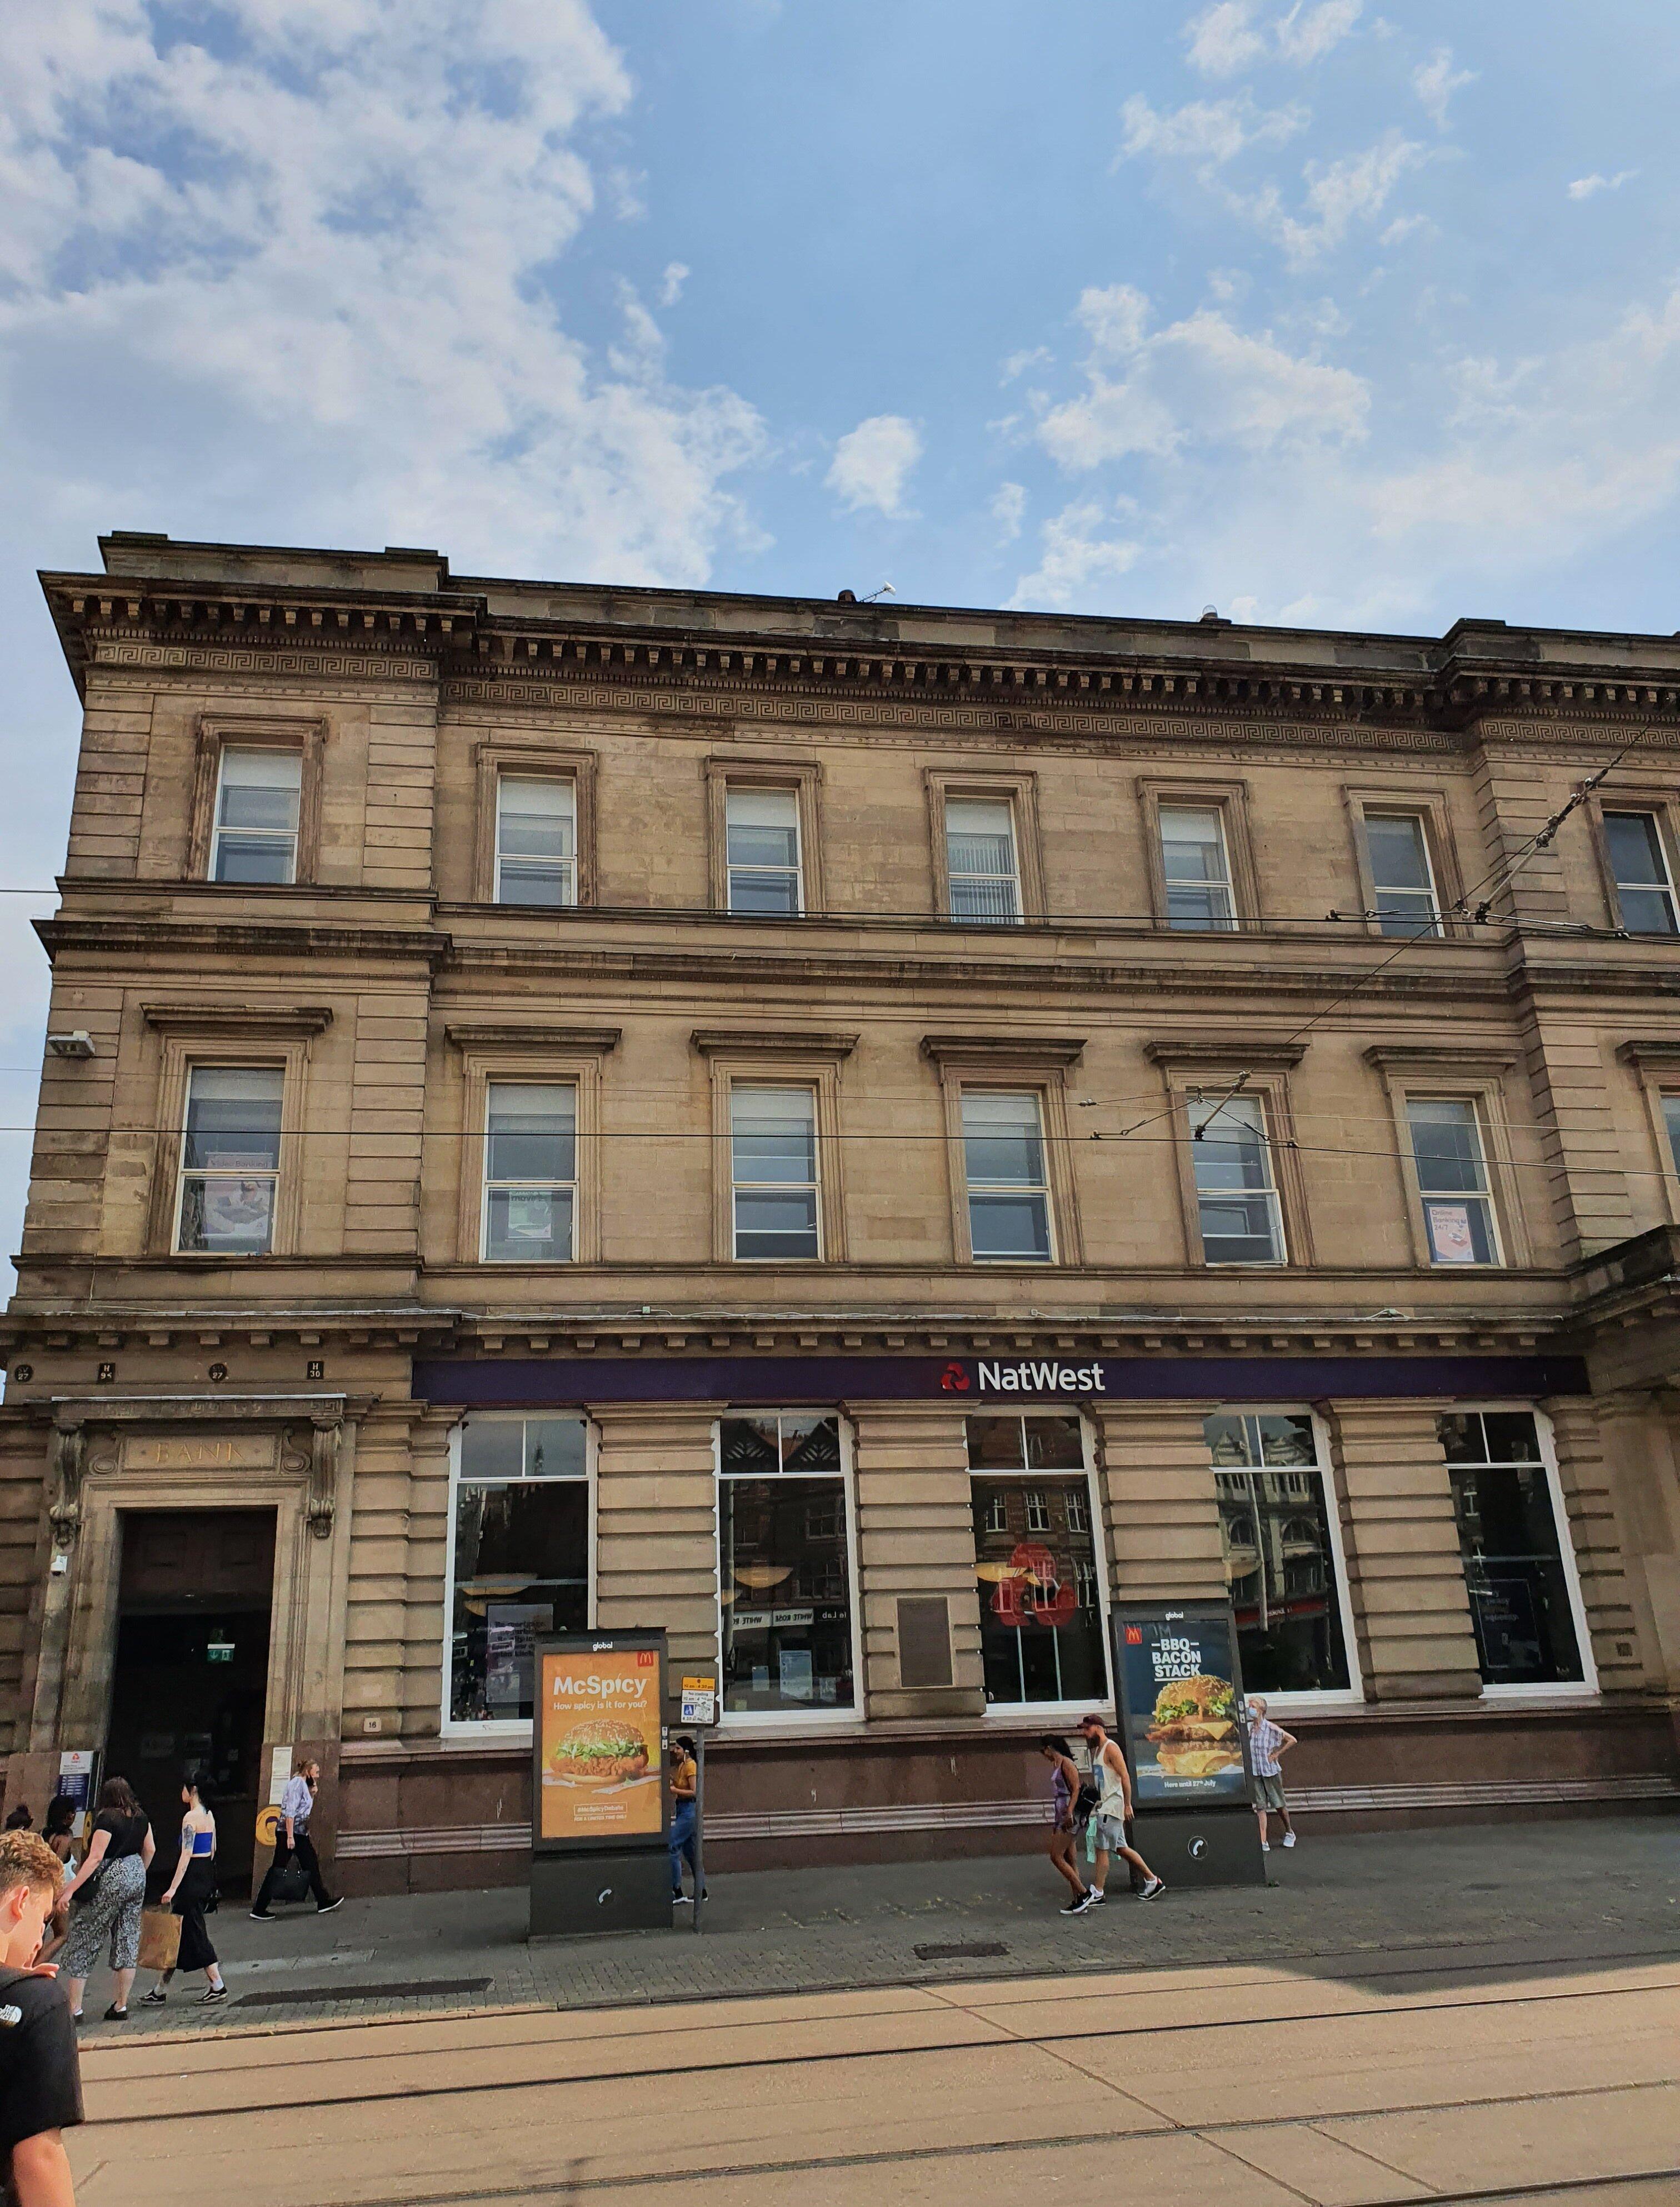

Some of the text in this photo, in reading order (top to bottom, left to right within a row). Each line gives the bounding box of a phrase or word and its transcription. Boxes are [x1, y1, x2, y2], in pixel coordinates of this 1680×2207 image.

[978, 1362, 1106, 1391] NatWest
[157, 1441, 246, 1462] BANK
[1166, 1611, 1184, 1621] global
[592, 1641, 613, 1651] global
[1152, 1650, 1202, 1664] BACON
[1154, 1664, 1201, 1677] STACK
[553, 1674, 648, 1699] McSpicy
[573, 1701, 596, 1711] spicy
[597, 1701, 604, 1709] is
[606, 1700, 612, 1709] it
[614, 1700, 626, 1709] for
[628, 1700, 648, 1710] you?
[1204, 1779, 1216, 1787] July
